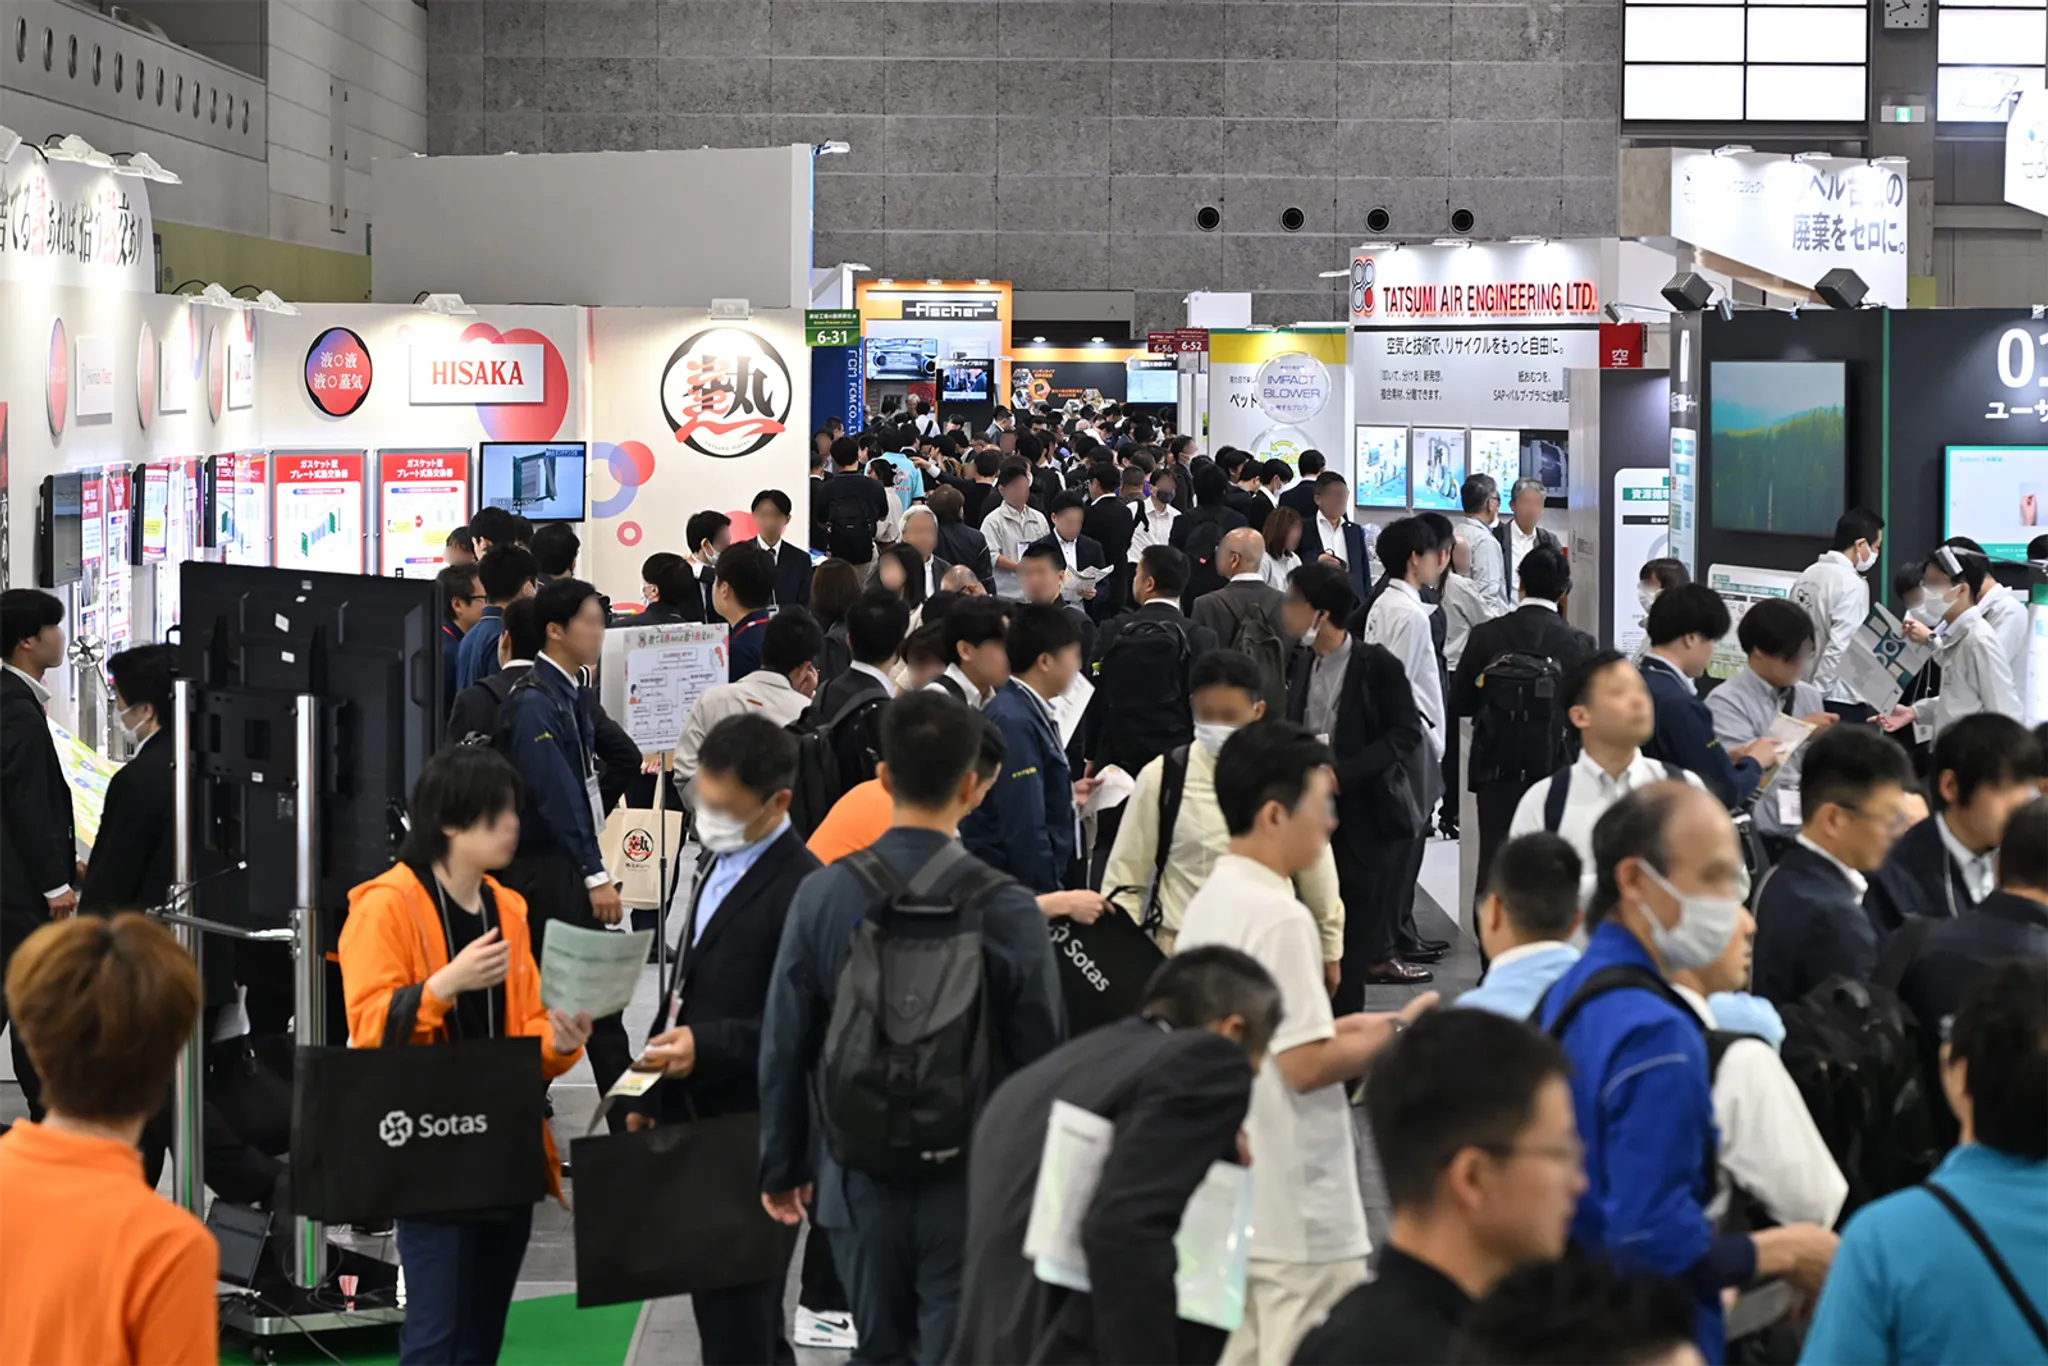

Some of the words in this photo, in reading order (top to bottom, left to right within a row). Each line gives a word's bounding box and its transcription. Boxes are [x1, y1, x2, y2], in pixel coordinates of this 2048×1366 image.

[1383, 286, 1436, 312] TATSUMI
[1440, 286, 1463, 312] AIR
[1467, 282, 1562, 312] ENGINEERING
[1566, 282, 1596, 312] LTD.
[817, 330, 848, 344] 6-31
[1154, 344, 1173, 352] 6-56
[1181, 341, 1202, 351] 6-52
[432, 360, 524, 385] HISAKA
[1267, 375, 1316, 385] IMPACT
[1263, 388, 1320, 399] BLOWER
[1063, 938, 1111, 992] Sotas
[418, 1113, 488, 1138] Sotas
